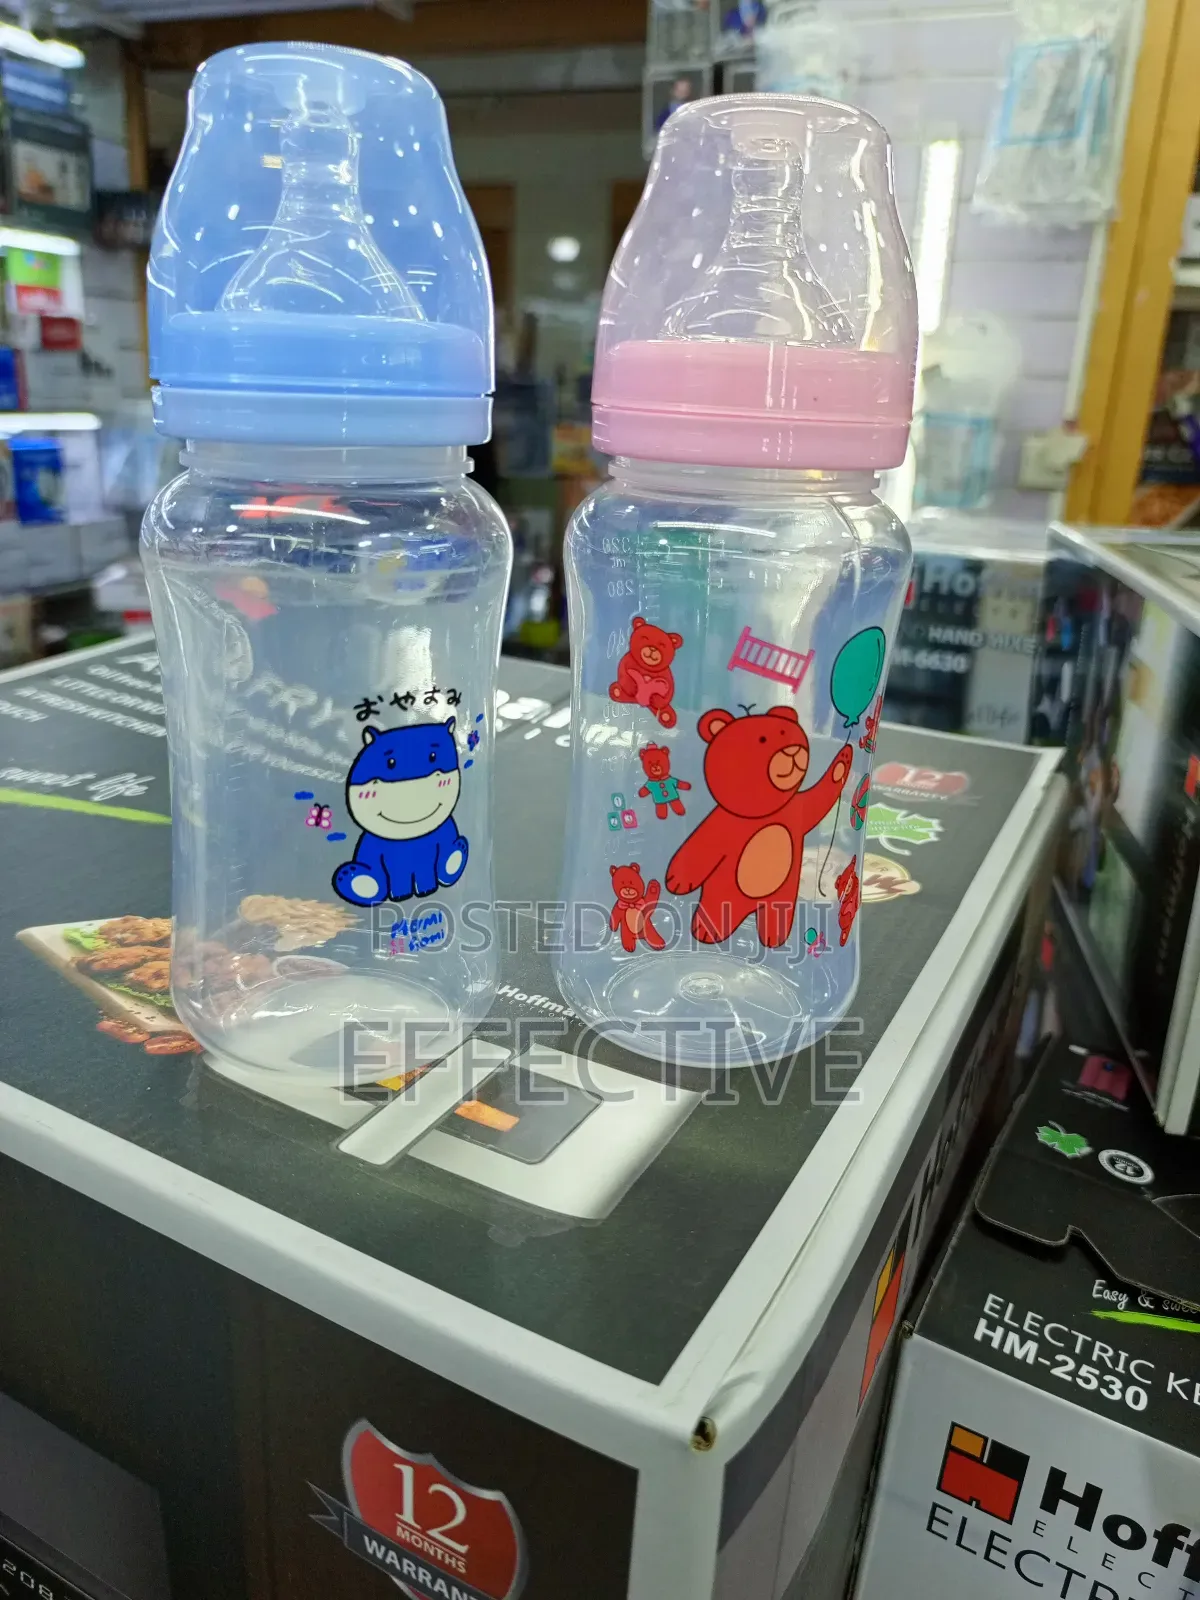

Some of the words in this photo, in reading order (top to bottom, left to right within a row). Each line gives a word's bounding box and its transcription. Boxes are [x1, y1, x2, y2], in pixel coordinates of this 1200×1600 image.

[983, 1293, 1155, 1385] ELECTRIC
[1092, 1280, 1128, 1310] Easy
[973, 1317, 1149, 1412] HM-2530
[393, 1463, 470, 1554] 12
[396, 1525, 467, 1574] MONTHS
